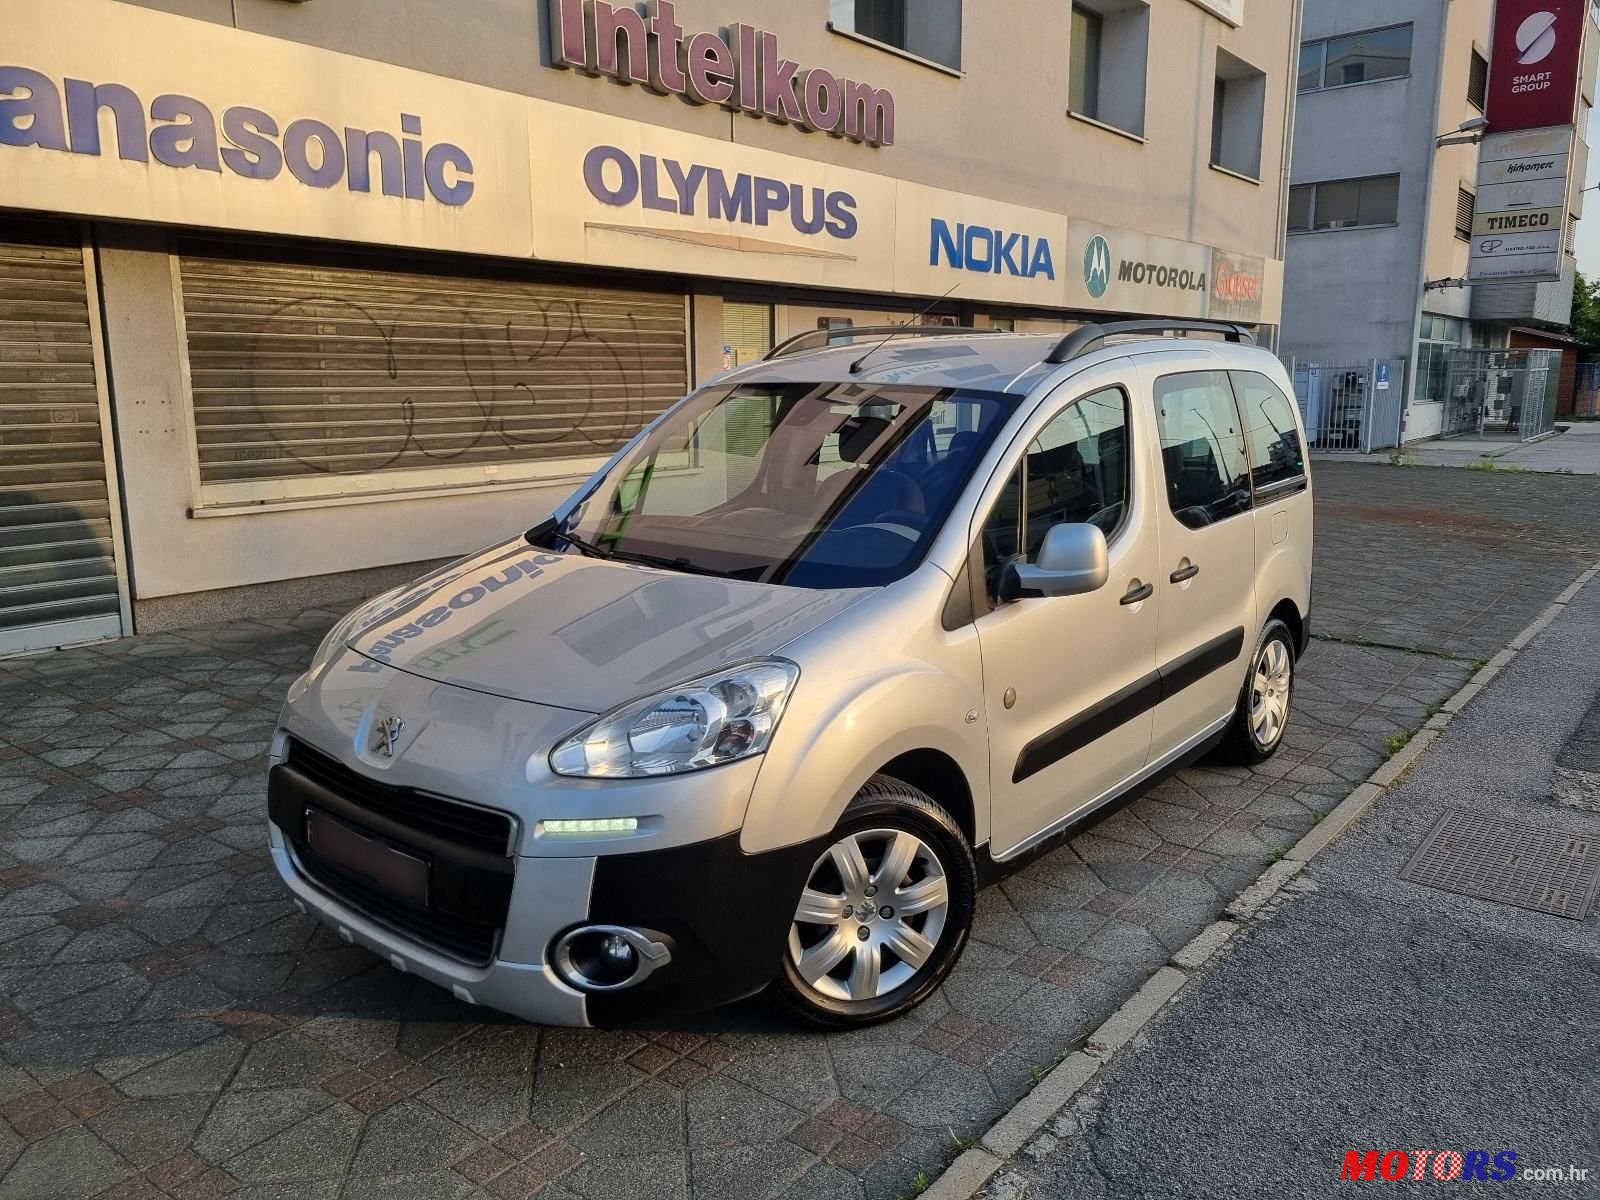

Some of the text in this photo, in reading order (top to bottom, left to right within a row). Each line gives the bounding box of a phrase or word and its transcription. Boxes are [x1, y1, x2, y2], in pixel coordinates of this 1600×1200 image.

[558, 0, 895, 146] Intelkom
[1511, 81, 1551, 94] GROUP
[1512, 71, 1552, 85] SMART
[582, 144, 858, 239] OLYMPUS
[1487, 212, 1549, 230] TIMECO
[929, 217, 1055, 281] NOKIA
[1118, 259, 1206, 293] MOTOROLA
